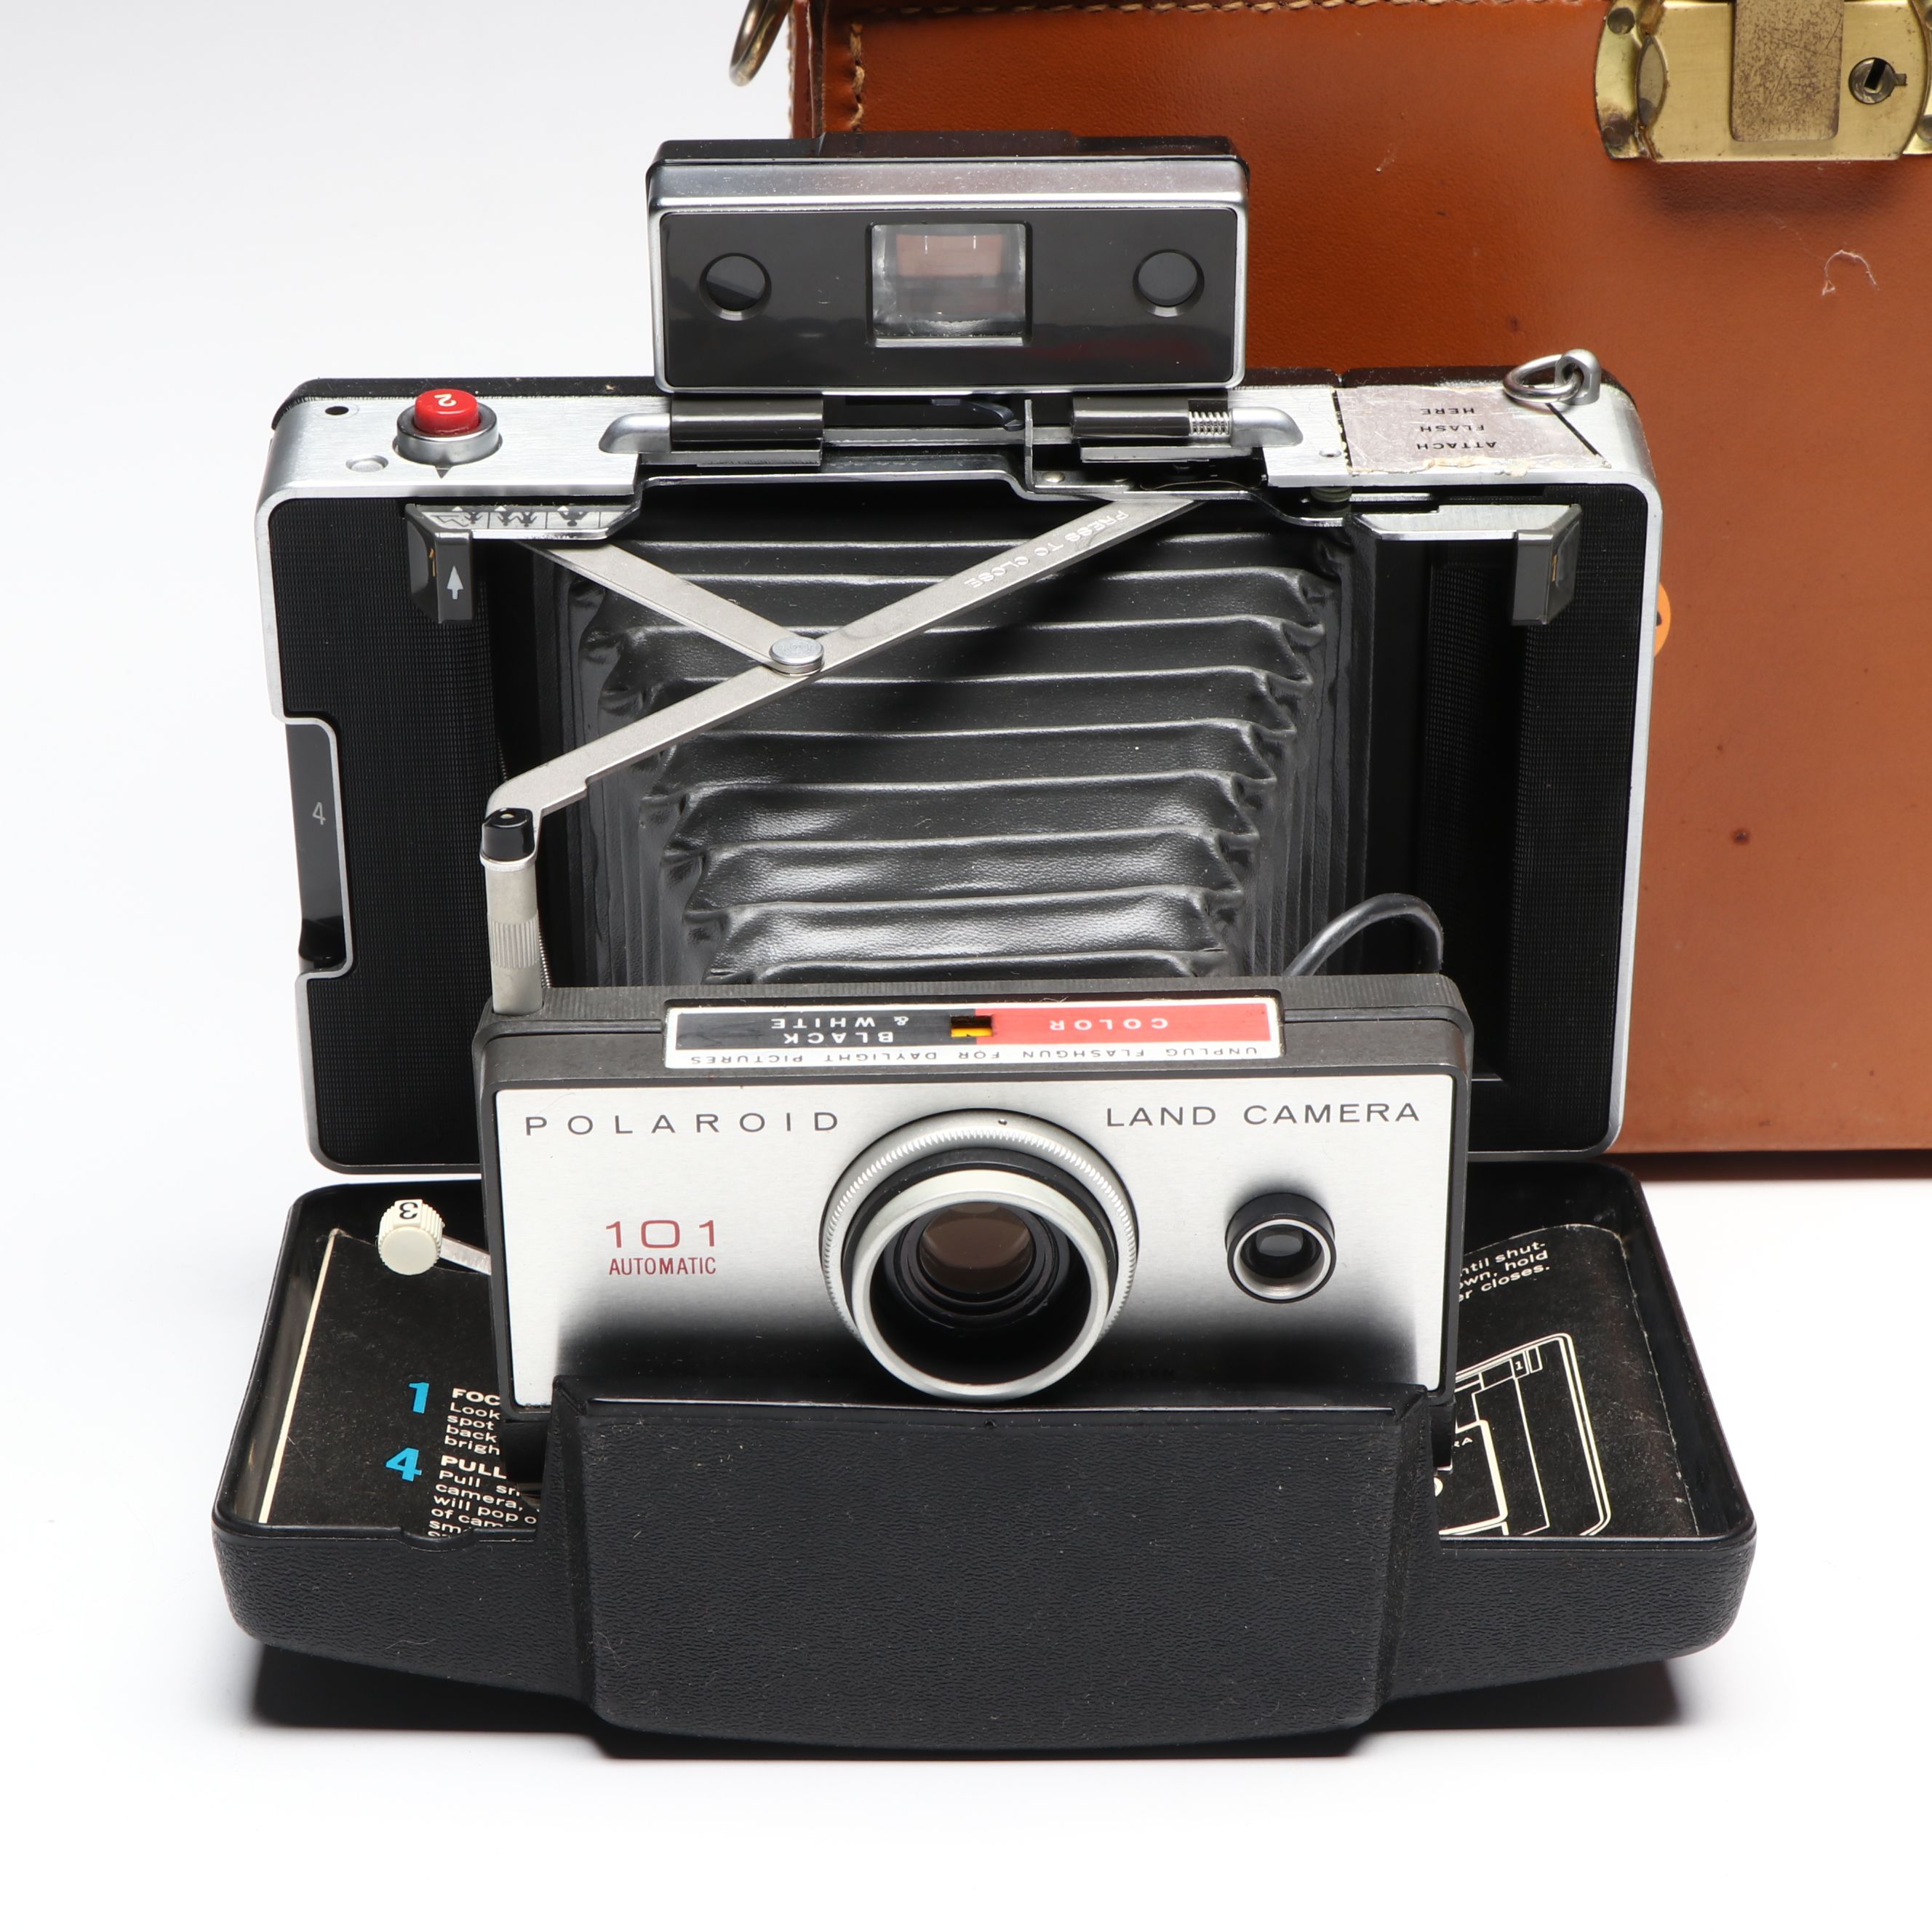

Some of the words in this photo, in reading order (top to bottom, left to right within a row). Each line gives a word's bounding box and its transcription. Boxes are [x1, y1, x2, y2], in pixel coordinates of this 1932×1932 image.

[434, 394, 457, 407] 2
[1416, 442, 1497, 450] ATTACH
[1064, 510, 1129, 542] PRESS
[1034, 542, 1063, 556] TO
[964, 556, 1030, 588] CLOSE
[313, 802, 326, 825] 4
[771, 1017, 876, 1029] WHITE
[894, 1016, 909, 1026] &
[1050, 1018, 1168, 1031] COLOR
[783, 1031, 894, 1045] BLACK
[691, 1053, 803, 1064] PICTURES
[825, 1052, 937, 1061] DAYLIGHT
[959, 1050, 999, 1060] FOR
[1023, 1048, 1144, 1058] FLASHGUN
[1166, 1047, 1258, 1056] UNPLUG
[525, 1112, 838, 1136] POLAROID
[1106, 1106, 1216, 1127] LAND
[1244, 1103, 1420, 1125] CAMERA
[399, 1202, 418, 1219] 3
[605, 1219, 716, 1248] 101
[1496, 1242, 1545, 1263] shut-
[1505, 1250, 1548, 1271] hold
[609, 1256, 716, 1275] AUTOMATIC
[1481, 1264, 1550, 1291] closes.
[1515, 1360, 1523, 1370] 1
[409, 1382, 429, 1414] 1
[452, 1388, 500, 1405] FOC
[450, 1402, 500, 1420] Look
[447, 1415, 494, 1430] spot
[446, 1424, 498, 1442] back
[444, 1435, 500, 1455] brigh
[386, 1447, 422, 1482] 4
[441, 1455, 507, 1480] PULL
[439, 1470, 481, 1488] Pull
[436, 1484, 523, 1512] camera,
[431, 1508, 454, 1519] of
[434, 1496, 471, 1511] will
[477, 1506, 519, 1522] pop
[524, 1516, 537, 1524] o
